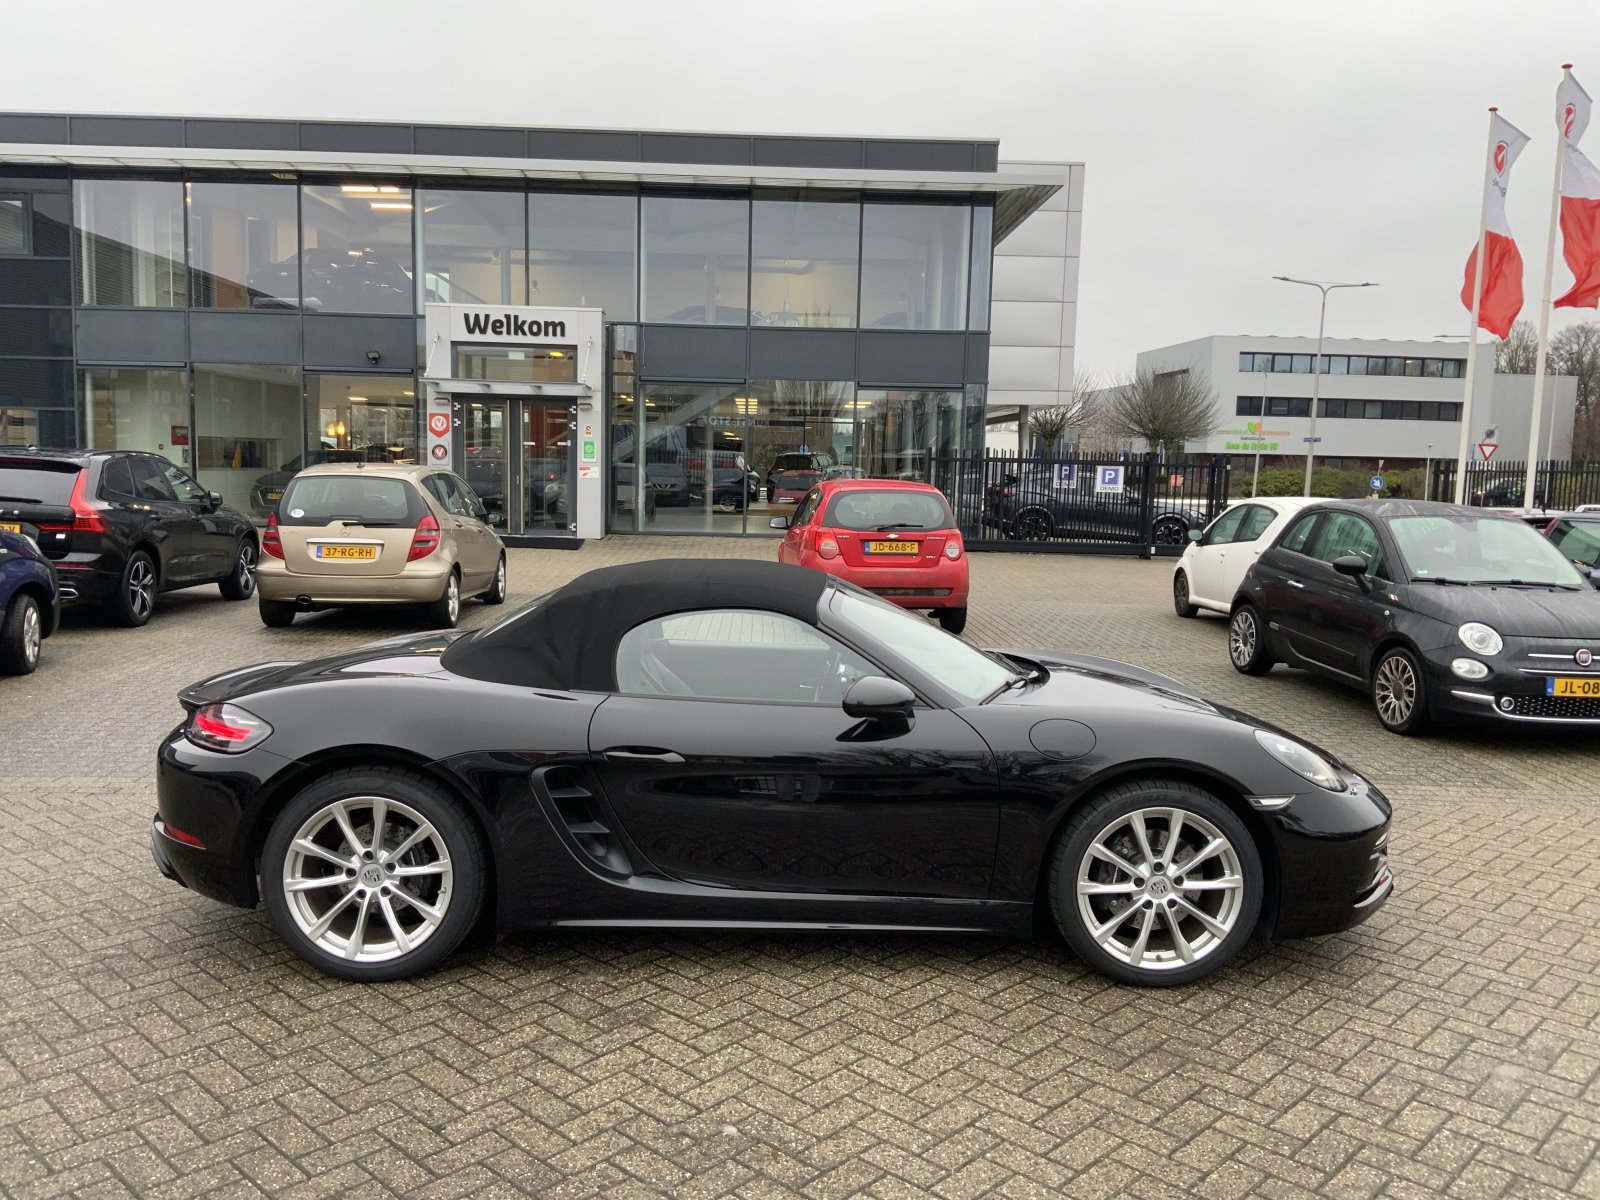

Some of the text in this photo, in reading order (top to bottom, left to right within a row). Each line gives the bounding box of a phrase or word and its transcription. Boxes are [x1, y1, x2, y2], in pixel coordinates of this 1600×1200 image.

[463, 312, 566, 337] Welkom
[1061, 466, 1070, 479] P
[1104, 470, 1116, 483] P
[325, 547, 372, 557] 37-RG-RH
[873, 542, 916, 552] JD-668-F
[1560, 681, 1600, 694] JL-08
